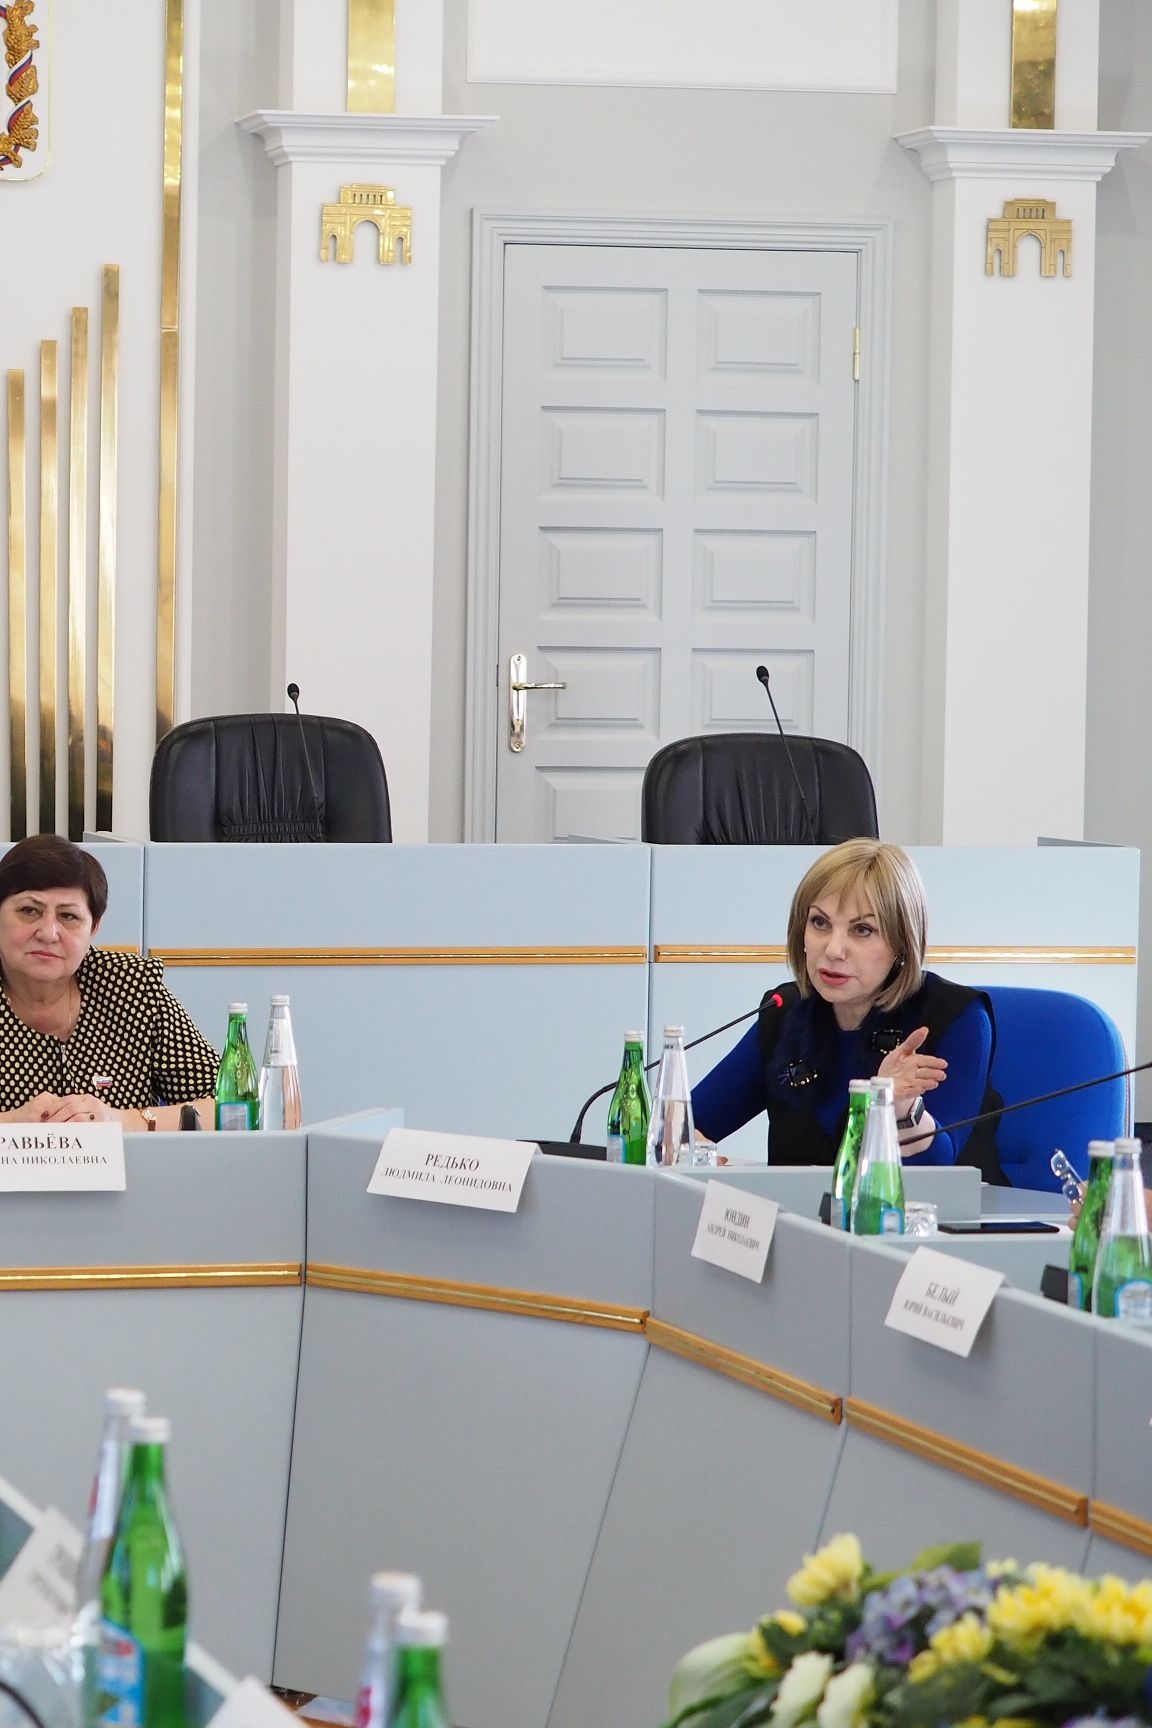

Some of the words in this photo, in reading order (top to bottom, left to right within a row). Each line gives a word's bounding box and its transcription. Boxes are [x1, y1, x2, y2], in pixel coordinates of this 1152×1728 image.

[22, 1155, 107, 1165] НИКОЛАЕВНА
[424, 1153, 480, 1172] РЕДЬКО
[382, 1167, 436, 1183] ЛЮДМИЛА
[440, 1175, 512, 1192] ЛЕОНИДОВНА
[925, 1282, 959, 1306] БЕЛЫЙ
